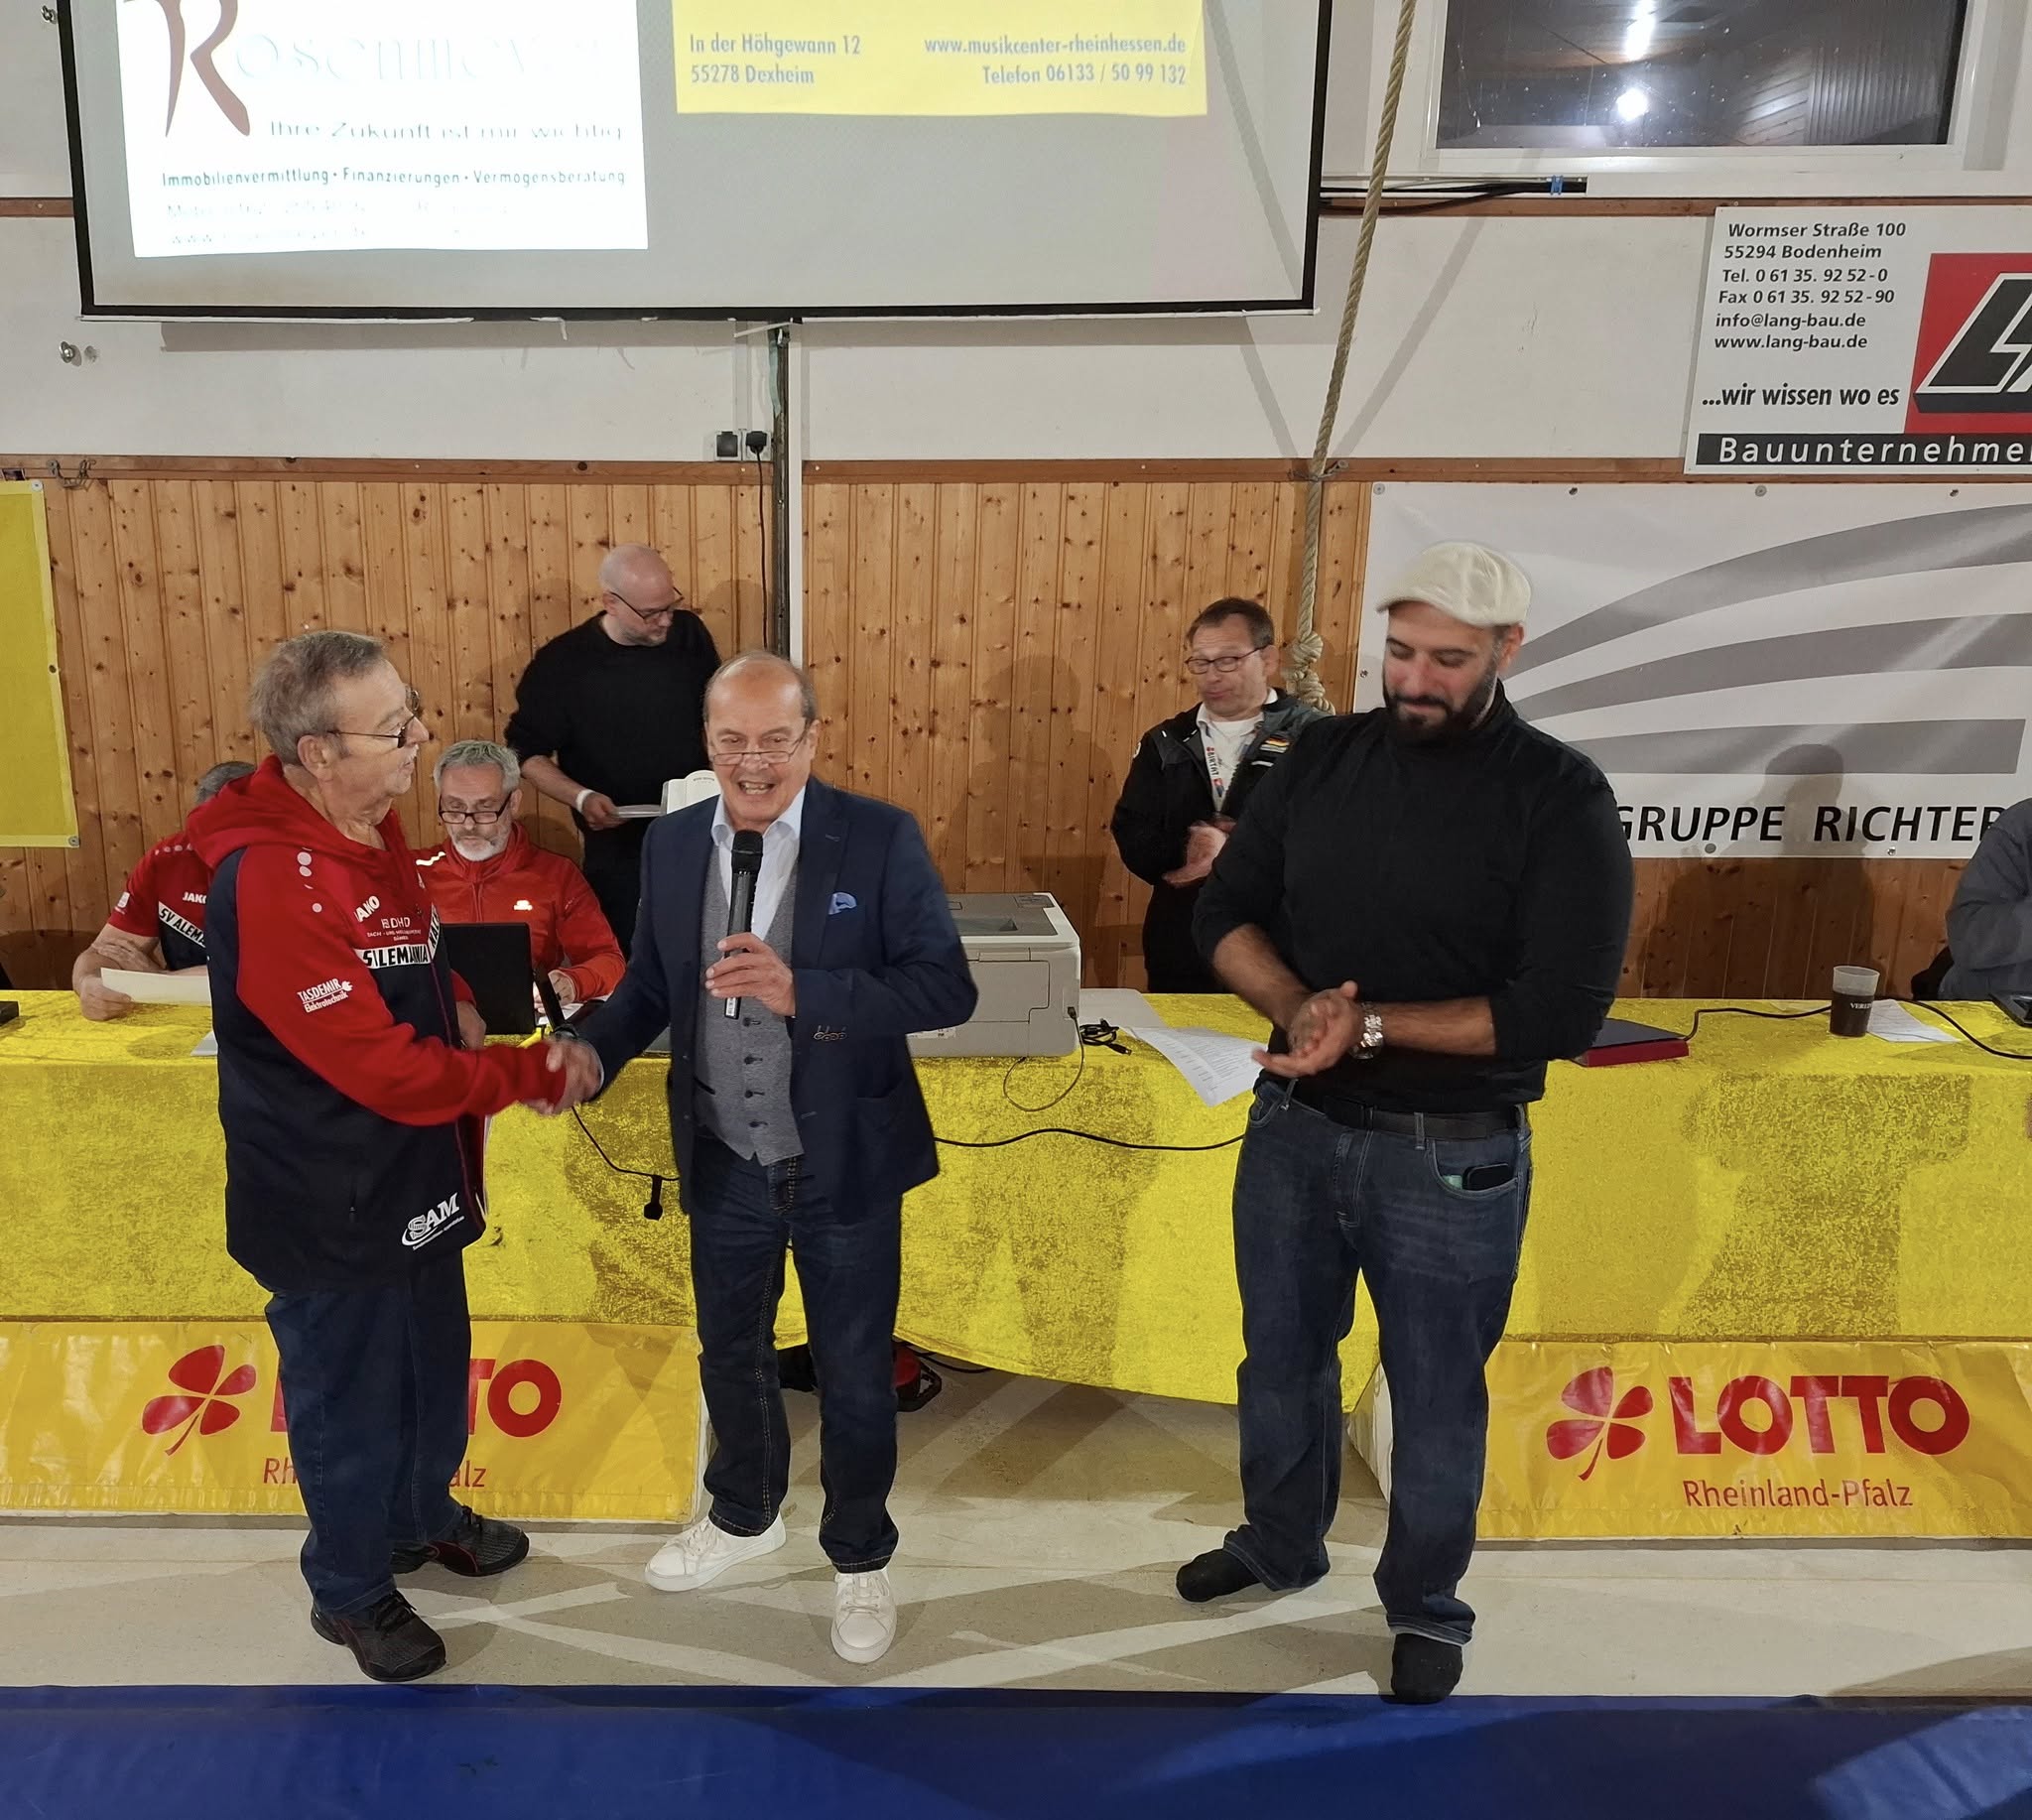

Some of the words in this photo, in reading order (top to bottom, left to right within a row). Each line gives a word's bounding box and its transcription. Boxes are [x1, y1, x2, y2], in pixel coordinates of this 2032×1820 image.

[690, 34, 704, 53] In
[710, 32, 736, 53] der
[742, 32, 836, 59] Höhgewann
[843, 35, 861, 55] 12
[924, 34, 1186, 54] www.musikcenter-rheinhessen.de
[692, 65, 739, 83] 55278
[745, 63, 815, 83] Dexheim
[982, 65, 1041, 84] Telefon
[1046, 64, 1094, 83] 06133
[1111, 64, 1130, 82] 50
[1135, 64, 1153, 82] 99
[1161, 64, 1187, 85] 132
[162, 168, 328, 187] Immobilienvermittlung
[1728, 223, 1808, 237] Wormser
[1812, 222, 1869, 237] Straße
[1876, 222, 1906, 236] 100
[1723, 245, 1776, 259] 55294
[1782, 245, 1882, 259] Bodenheim
[1722, 269, 1750, 282] Tel.
[1718, 291, 1747, 304] Fax
[1714, 314, 1866, 330] info@lang-bau.de
[1714, 334, 1868, 351] www.lang-bau.de
[1702, 383, 1756, 406] ...wir
[1762, 383, 1833, 406] wissen
[1839, 387, 1871, 406] wo
[1877, 387, 1900, 406] es
[1718, 436, 2032, 462] Bauunternehme
[297, 977, 342, 1002] TASDEMIR
[408, 1192, 460, 1240] SAM
[1669, 1375, 1970, 1456] LOTTO
[1683, 1479, 1913, 1507] Rheinland-Pfalz
